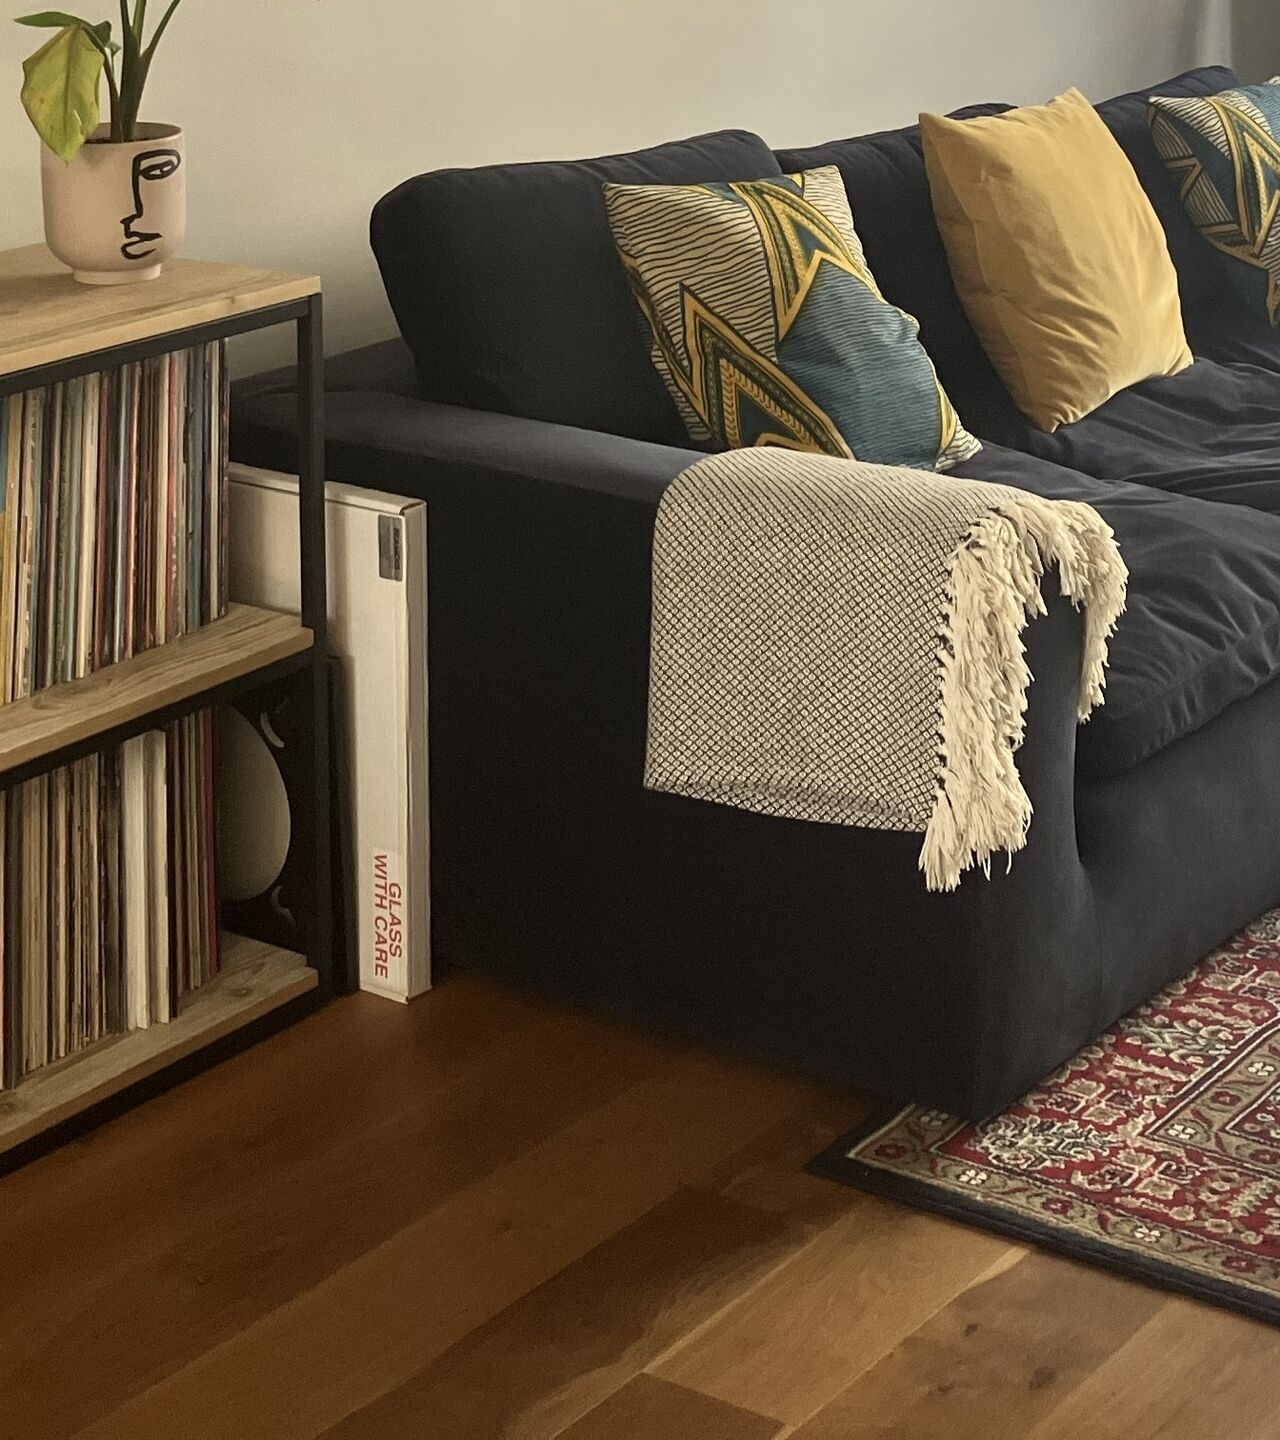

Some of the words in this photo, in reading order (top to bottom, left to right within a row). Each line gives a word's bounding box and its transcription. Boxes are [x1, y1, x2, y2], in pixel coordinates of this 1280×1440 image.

[374, 854, 388, 910] WITH
[374, 916, 388, 978] CARE
[388, 882, 402, 958] GLASS
